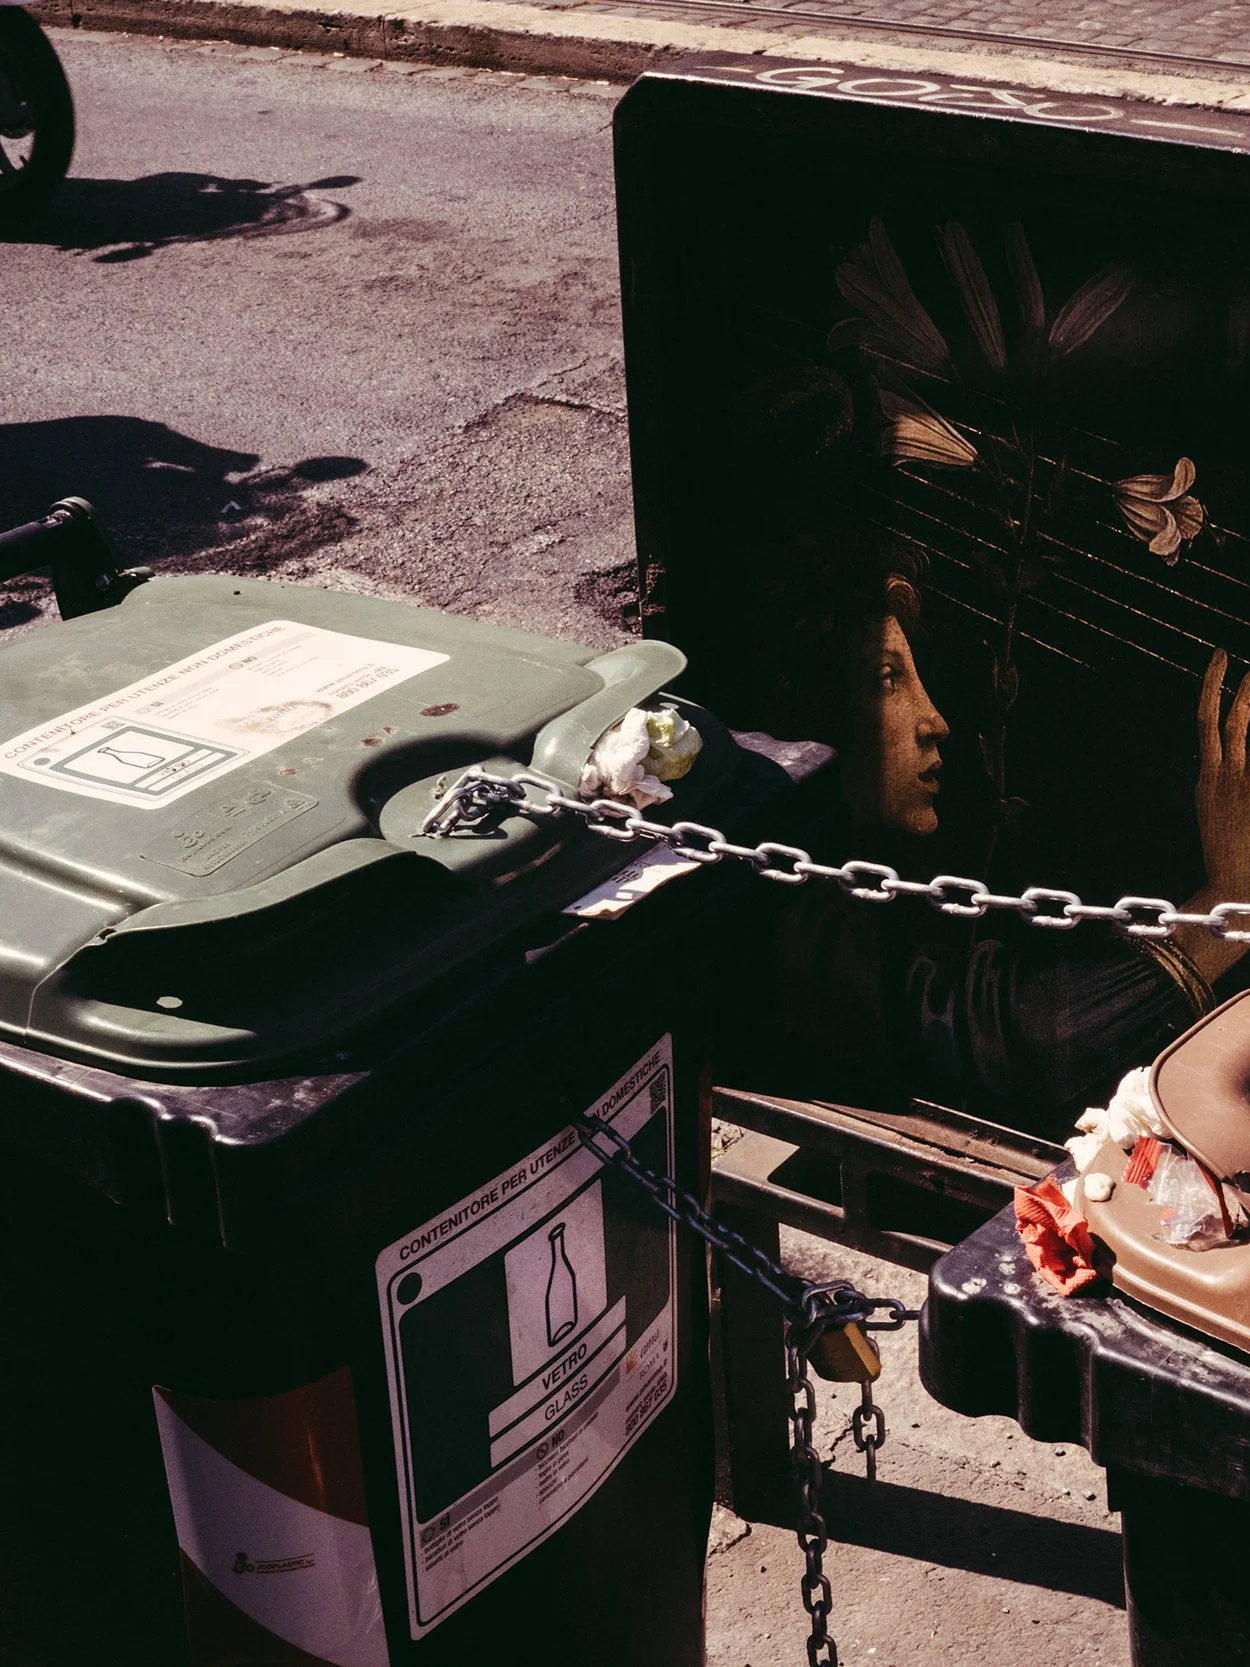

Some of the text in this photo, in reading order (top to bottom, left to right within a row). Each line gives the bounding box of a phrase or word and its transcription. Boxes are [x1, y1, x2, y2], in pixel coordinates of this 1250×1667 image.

[4, 712, 101, 758] CONTENITORE
[99, 699, 128, 711] PER
[128, 676, 180, 698] UTENZE
[178, 660, 208, 674] NON
[207, 627, 284, 660] DOMESTICHE
[399, 1051, 661, 1261] CONTENITORE PER UTENZE DOMESTICHE
[542, 1343, 587, 1390] VETRO
[545, 1374, 588, 1421] GLASS
[626, 1381, 667, 1435] 800 867 035
[551, 1430, 564, 1447] NO
